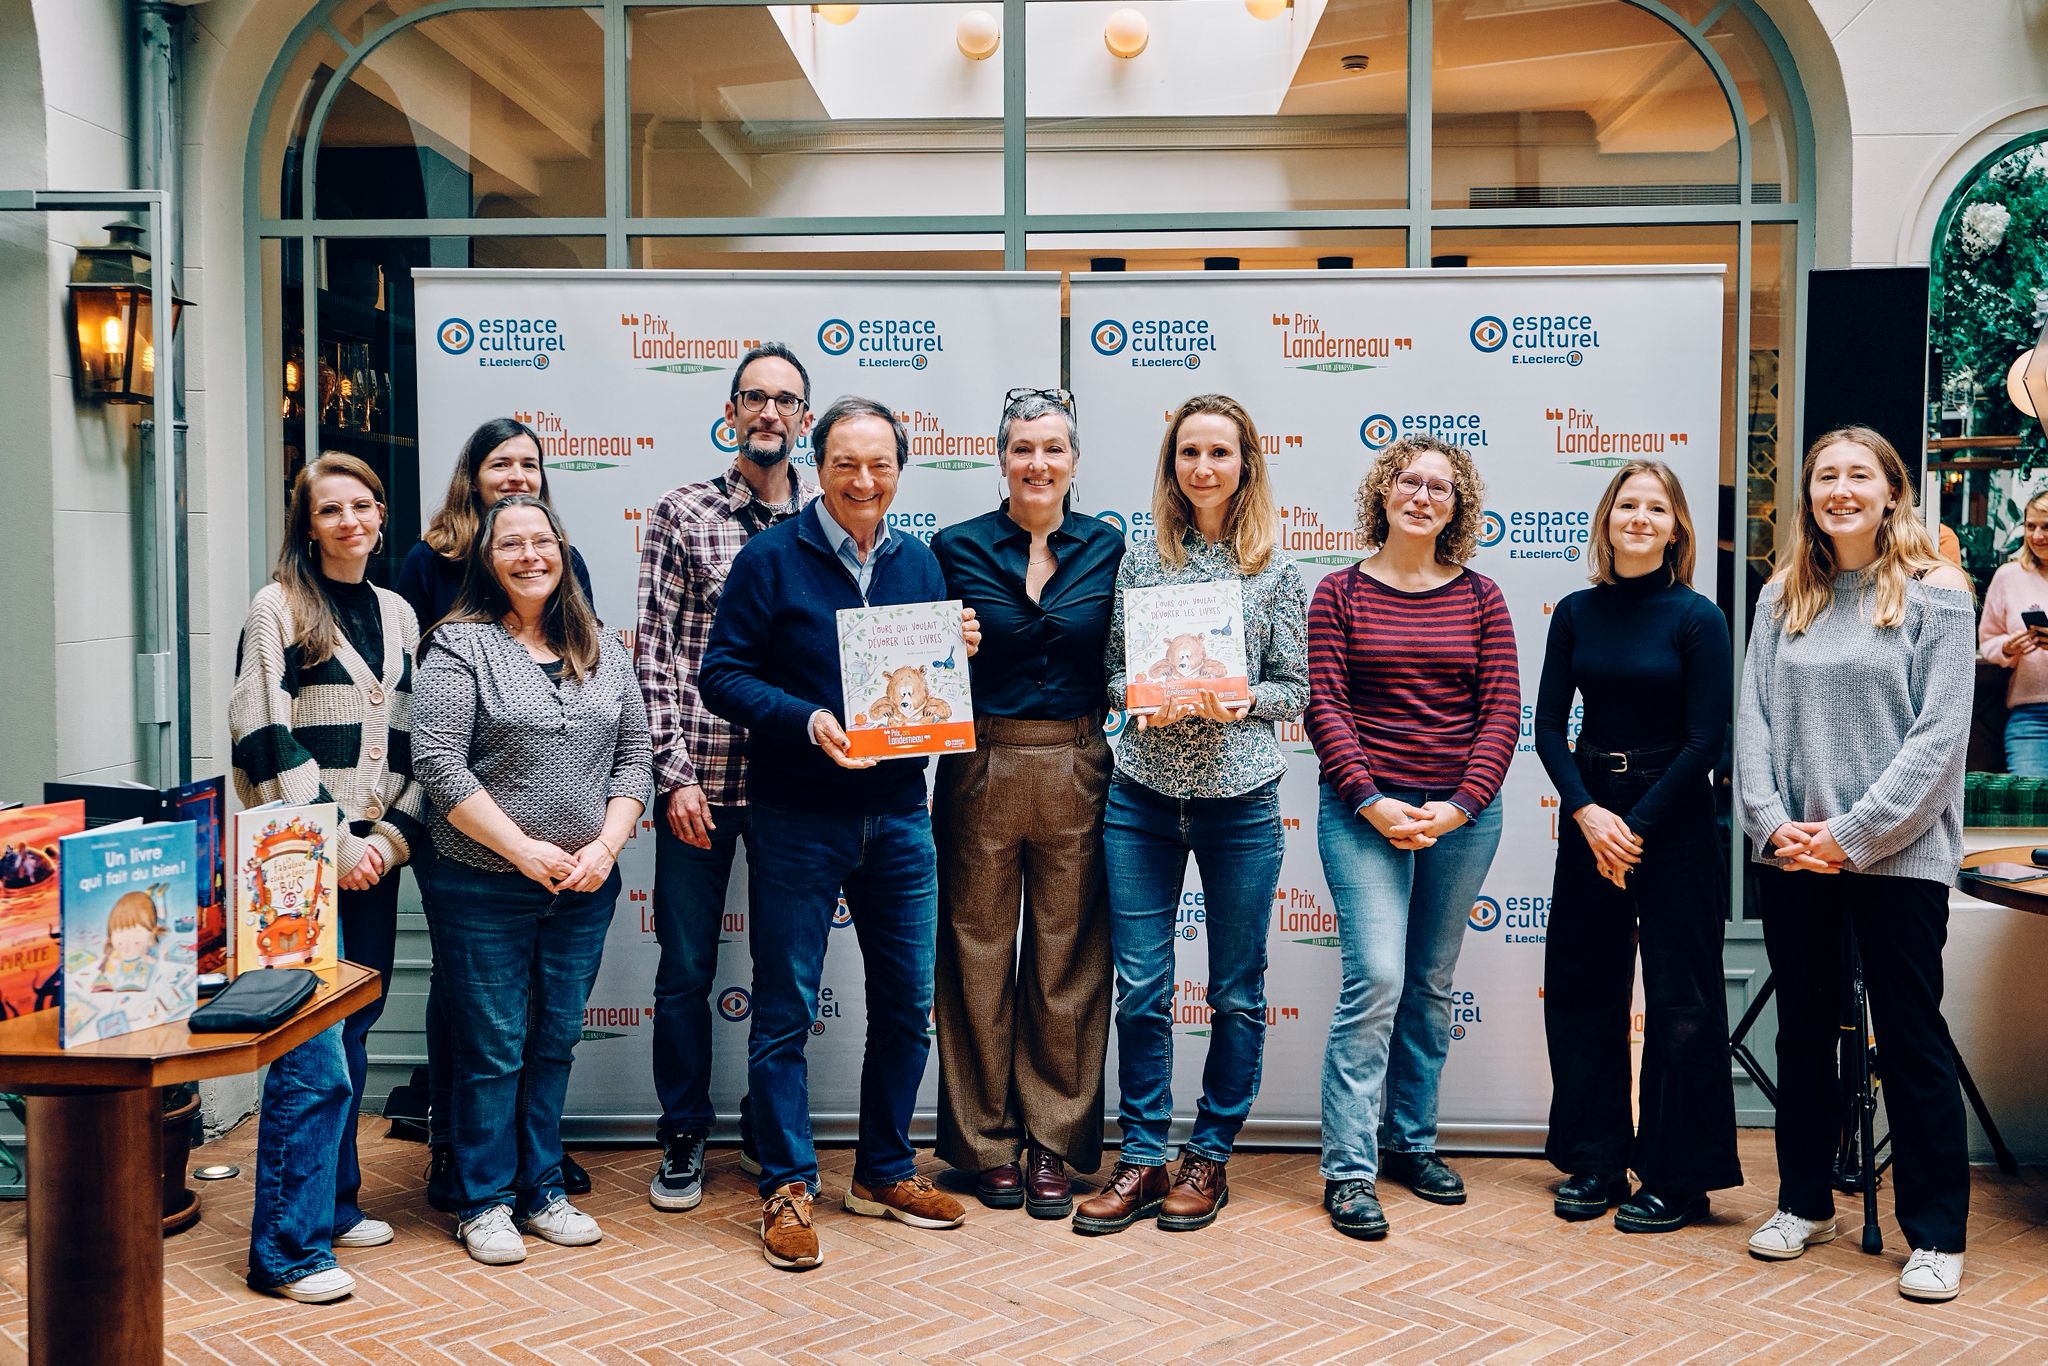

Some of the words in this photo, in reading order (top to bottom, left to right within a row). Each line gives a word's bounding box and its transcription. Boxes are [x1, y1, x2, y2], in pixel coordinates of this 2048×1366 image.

[479, 319, 557, 334] espace
[643, 313, 669, 335] Prix
[858, 320, 936, 335] espace
[1131, 319, 1209, 335] espace
[1294, 313, 1319, 335] Prix
[1511, 316, 1592, 333] espace
[479, 334, 565, 351] culturel
[632, 331, 738, 359] Landerneau
[858, 335, 944, 351] culturel
[1131, 334, 1217, 351] culturel
[1283, 331, 1390, 358] Landerneau
[1511, 331, 1600, 348] culturel
[537, 411, 562, 432] Prix
[914, 411, 939, 432] Prix
[1402, 414, 1481, 430] espace
[1568, 407, 1594, 428] Prix
[538, 429, 631, 456] anderneau
[906, 429, 996, 456] andernea
[1556, 425, 1664, 453] Landerneau
[886, 513, 937, 527] pace
[1293, 506, 1318, 528] Prix
[1510, 511, 1589, 527] espace
[1282, 523, 1365, 551] Landerne
[1510, 526, 1589, 543] culture
[903, 635, 915, 646] LES
[104, 850, 127, 868] Un
[130, 847, 163, 864] livre
[79, 873, 103, 893] qui
[105, 870, 129, 886] fait
[131, 867, 150, 881] du
[1291, 888, 1316, 909] Prix
[1505, 897, 1553, 912] espa
[1279, 905, 1337, 933] Lander
[1505, 911, 1548, 928] cult
[1505, 934, 1547, 943] E.Lecle
[583, 1007, 640, 1027] erneau
